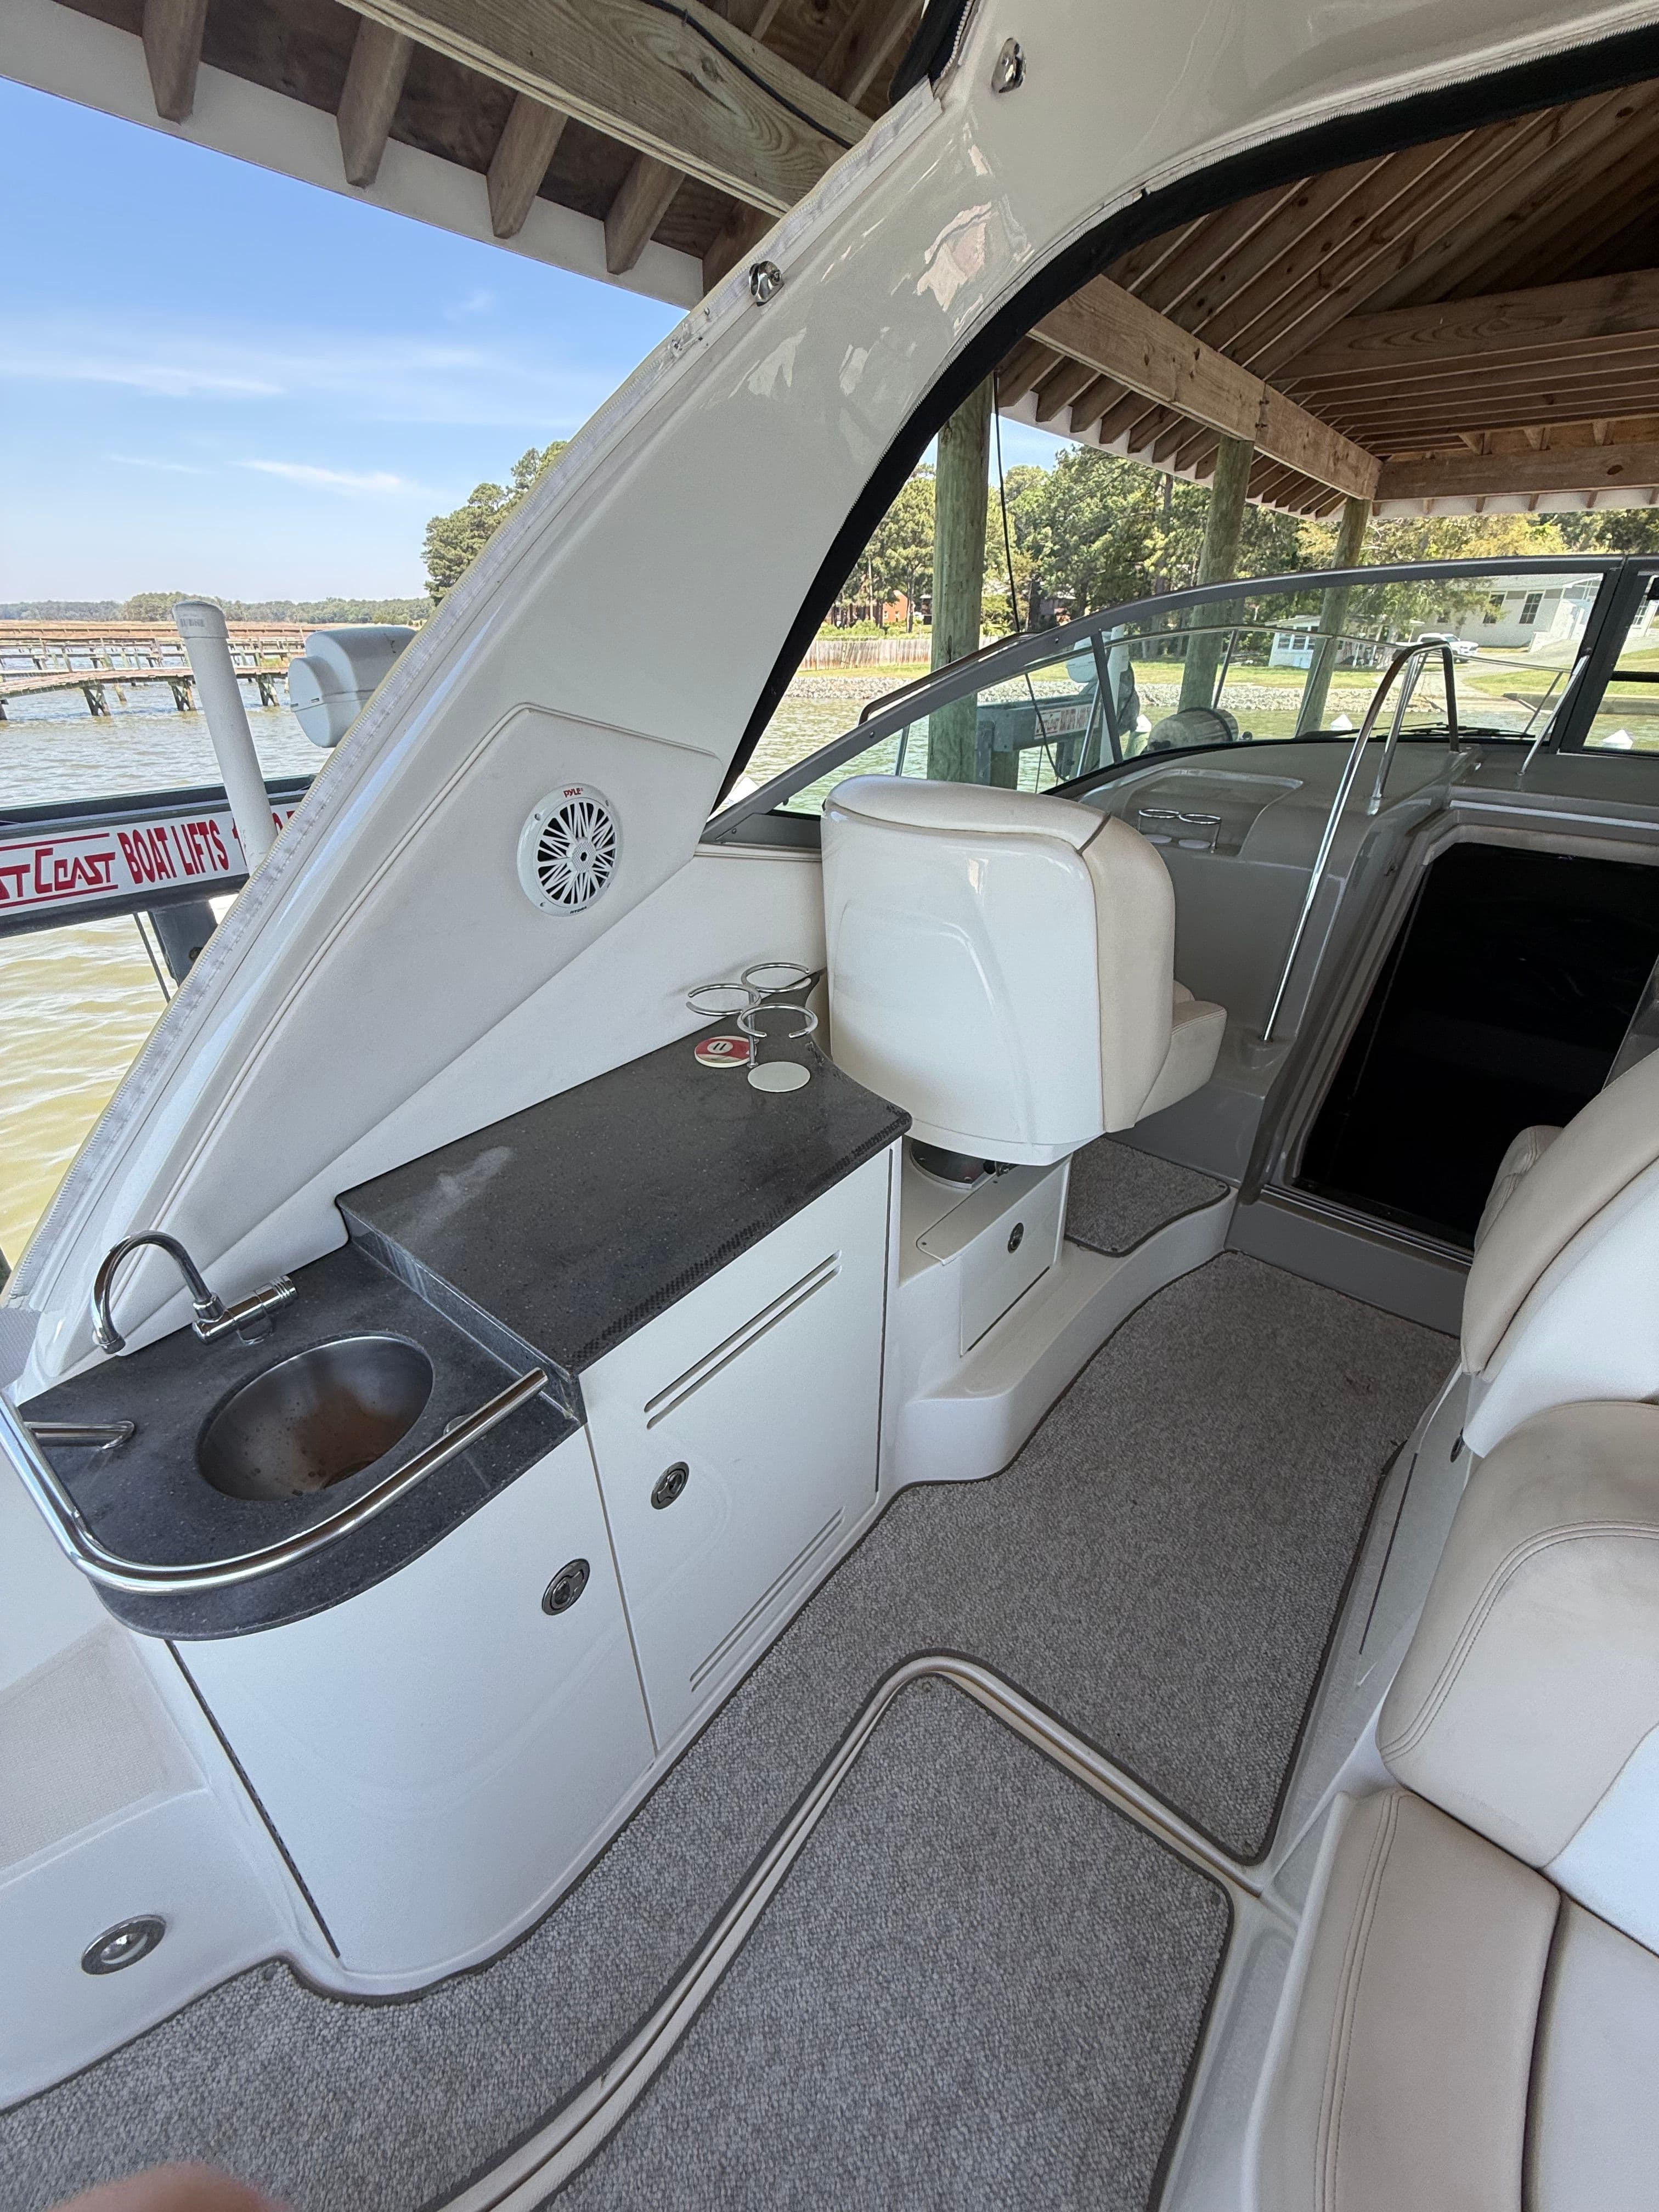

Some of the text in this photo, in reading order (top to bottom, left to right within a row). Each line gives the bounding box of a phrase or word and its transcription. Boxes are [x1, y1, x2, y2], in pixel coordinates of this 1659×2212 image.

[35, 848, 116, 894] COAST
[117, 827, 177, 884] BOAT
[171, 819, 229, 876] LIFTS
